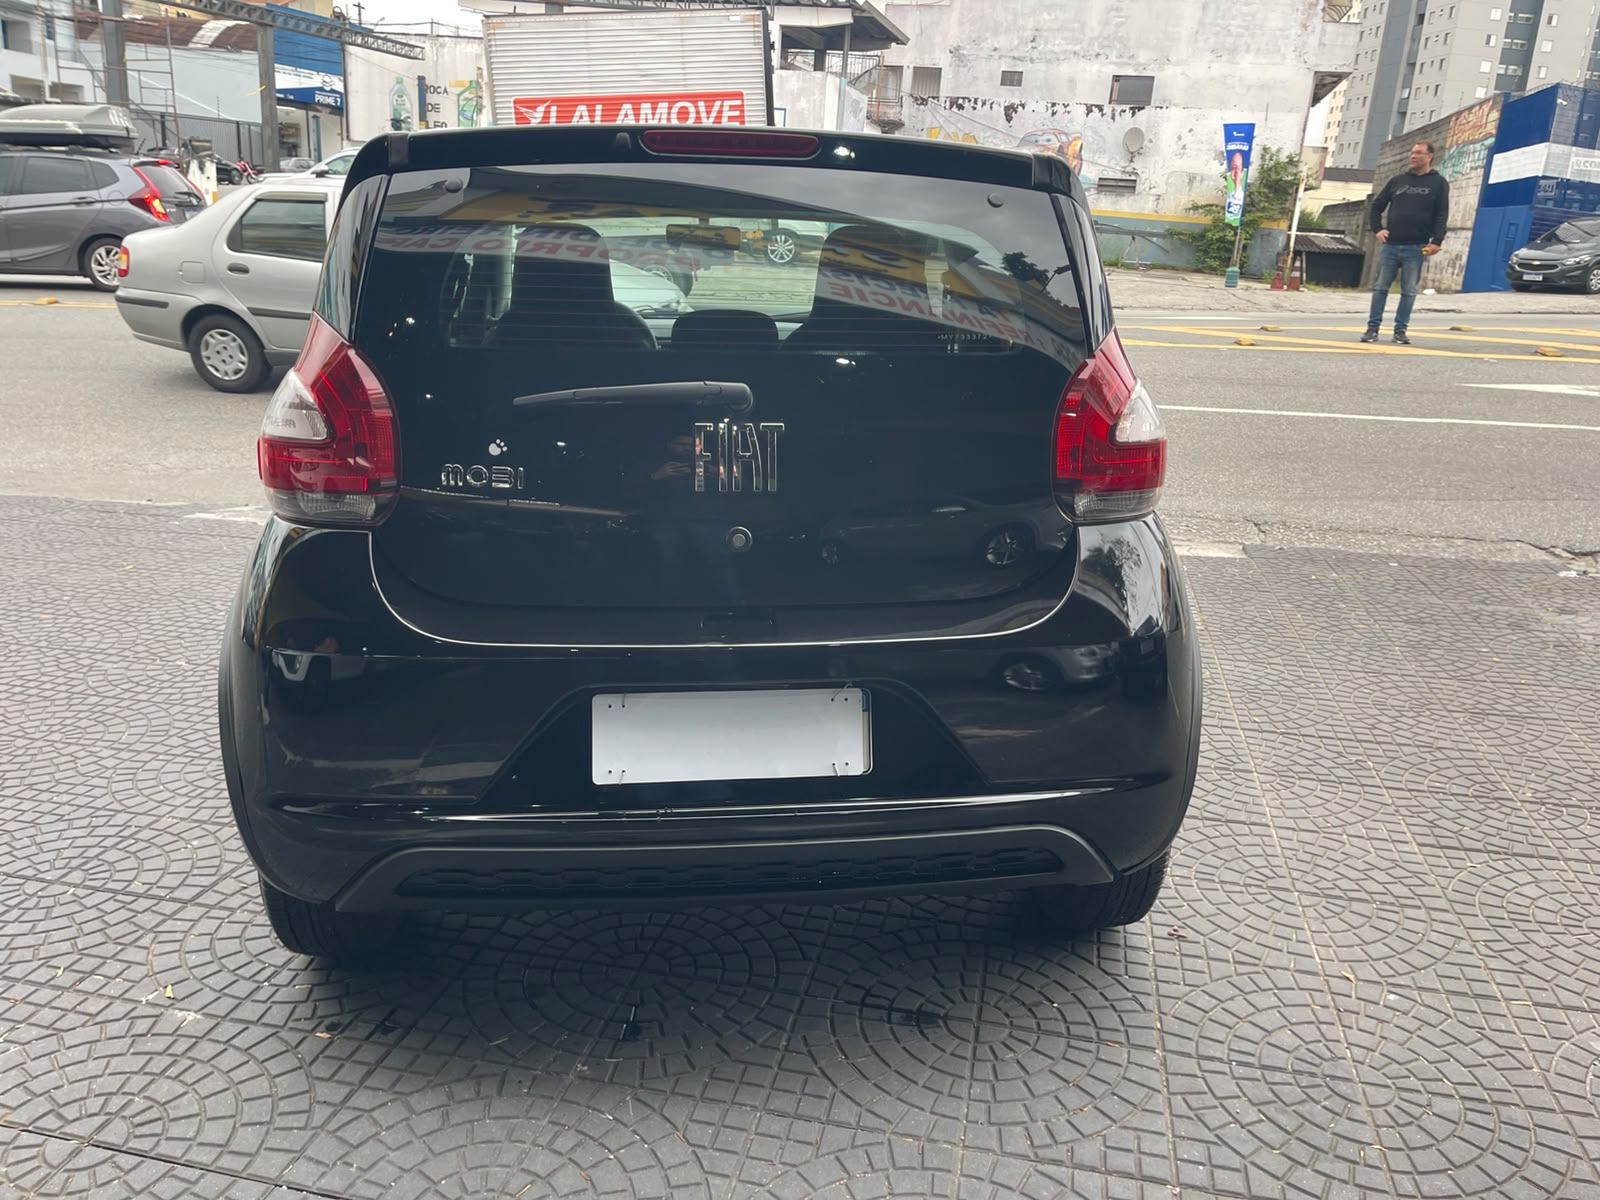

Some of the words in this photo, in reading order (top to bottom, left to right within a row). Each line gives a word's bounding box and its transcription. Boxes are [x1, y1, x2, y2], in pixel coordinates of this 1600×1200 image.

[424, 84, 449, 96] ROCA
[315, 94, 336, 106] PRIME
[427, 102, 441, 113] DE
[550, 100, 743, 125] LALAMOVE
[694, 421, 785, 493] FIAT
